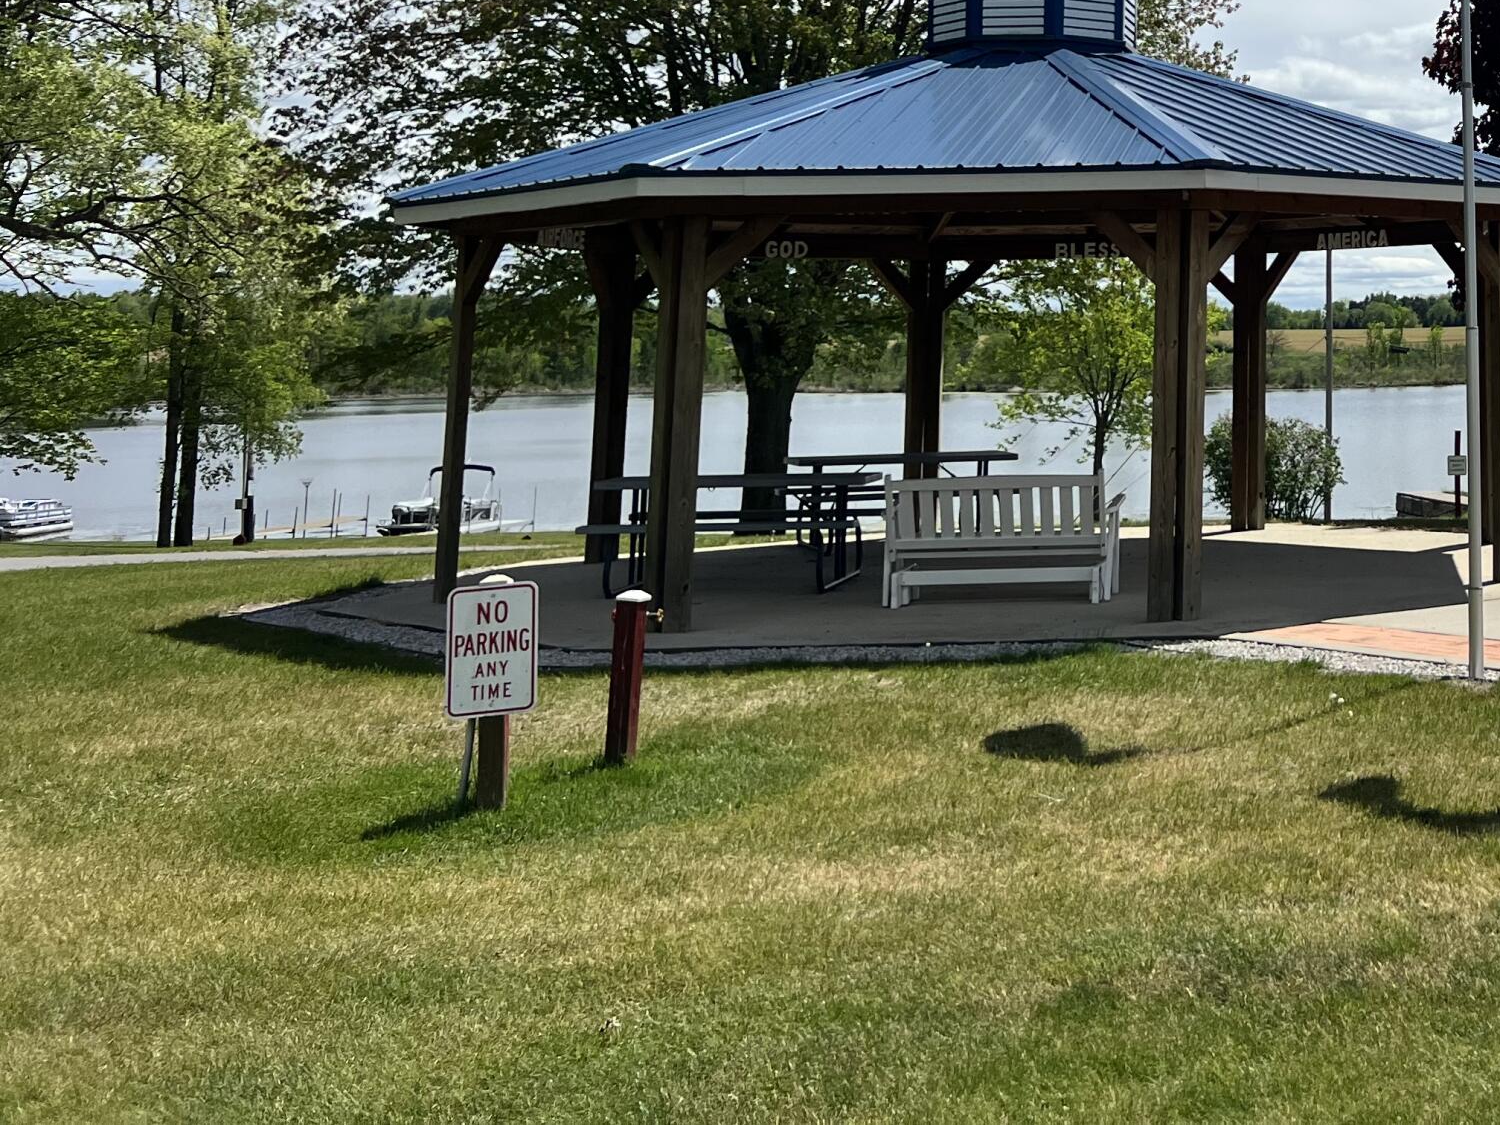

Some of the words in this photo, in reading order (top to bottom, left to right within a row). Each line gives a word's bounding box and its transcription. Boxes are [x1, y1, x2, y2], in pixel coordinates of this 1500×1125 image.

[765, 240, 809, 258] GOD
[1316, 229, 1390, 250] AMERICA
[1055, 242, 1121, 258] BLESS
[477, 600, 509, 625] NO
[454, 628, 530, 658] PARKING
[473, 660, 509, 679] ANY
[471, 682, 512, 701] TIME
